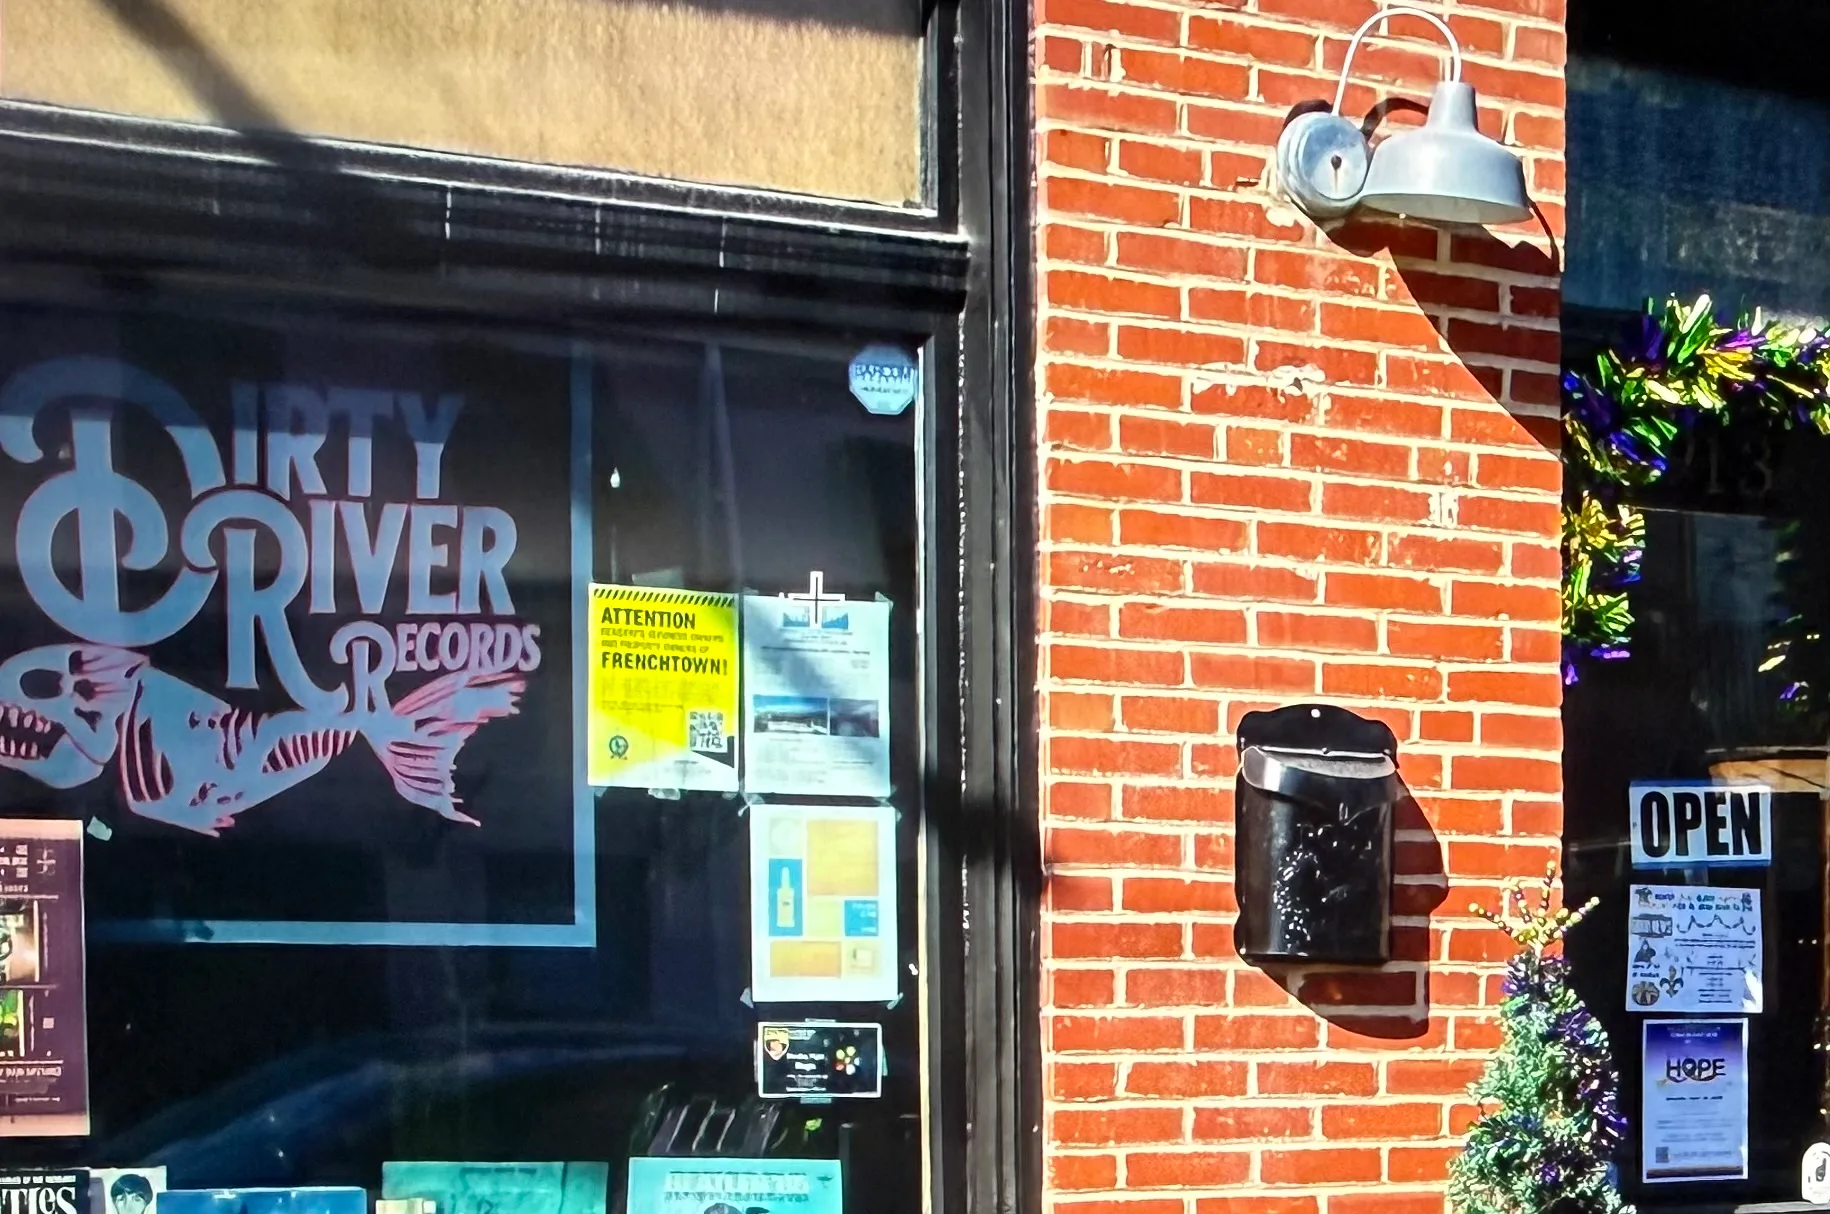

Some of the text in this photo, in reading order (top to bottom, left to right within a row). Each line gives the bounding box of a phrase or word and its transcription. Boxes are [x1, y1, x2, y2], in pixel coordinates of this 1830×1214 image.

[181, 490, 518, 713] RIVER
[600, 606, 696, 630] ATTENTION
[329, 621, 542, 714] RECORDS
[601, 651, 728, 676] FRENCHTOWN!
[1640, 791, 1762, 858] OPEN
[1666, 1057, 1726, 1079] HOPE
